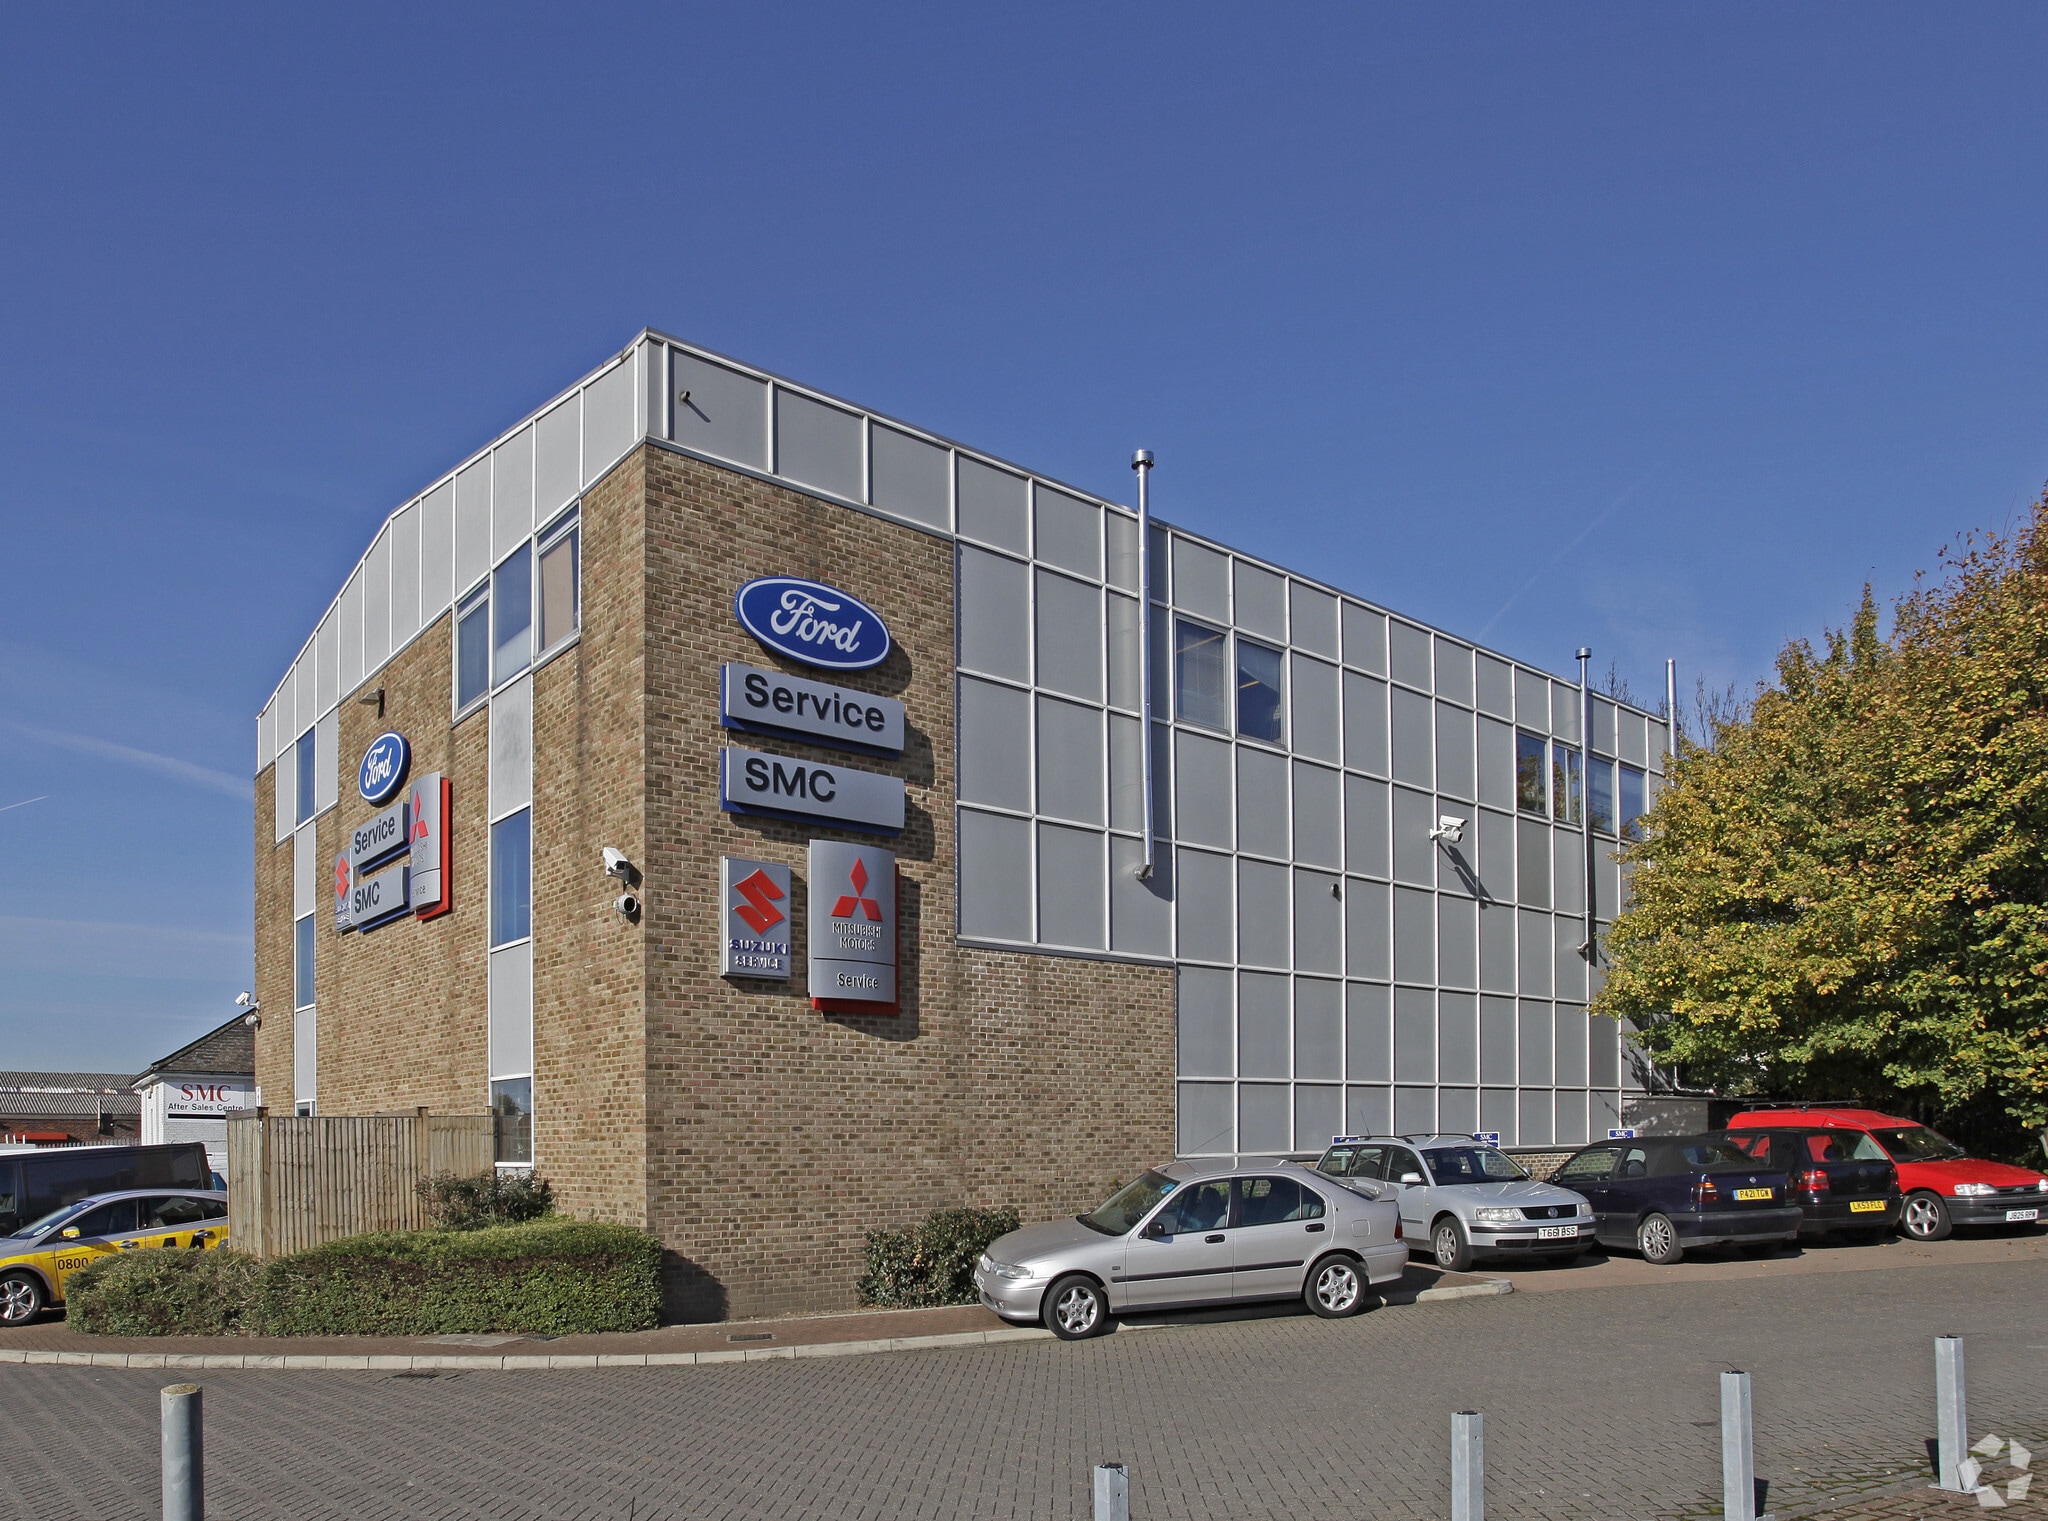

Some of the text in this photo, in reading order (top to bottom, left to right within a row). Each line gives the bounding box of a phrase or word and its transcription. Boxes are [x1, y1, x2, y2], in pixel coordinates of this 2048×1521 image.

[770, 589, 863, 653] Ford
[744, 673, 886, 733] Service
[364, 743, 393, 790] Ford
[744, 757, 837, 802] SMC
[354, 816, 396, 855] Service
[354, 881, 380, 914] SMC
[832, 921, 883, 939] MITSUBISHI
[729, 939, 789, 956] SUZUKI
[839, 937, 876, 951] MOTORS
[735, 955, 785, 971] SERVICE
[837, 972, 879, 989] Service
[181, 1083, 231, 1102] SMC
[168, 1103, 243, 1112] After Sales Centre
[57, 1257, 89, 1270] 0800
